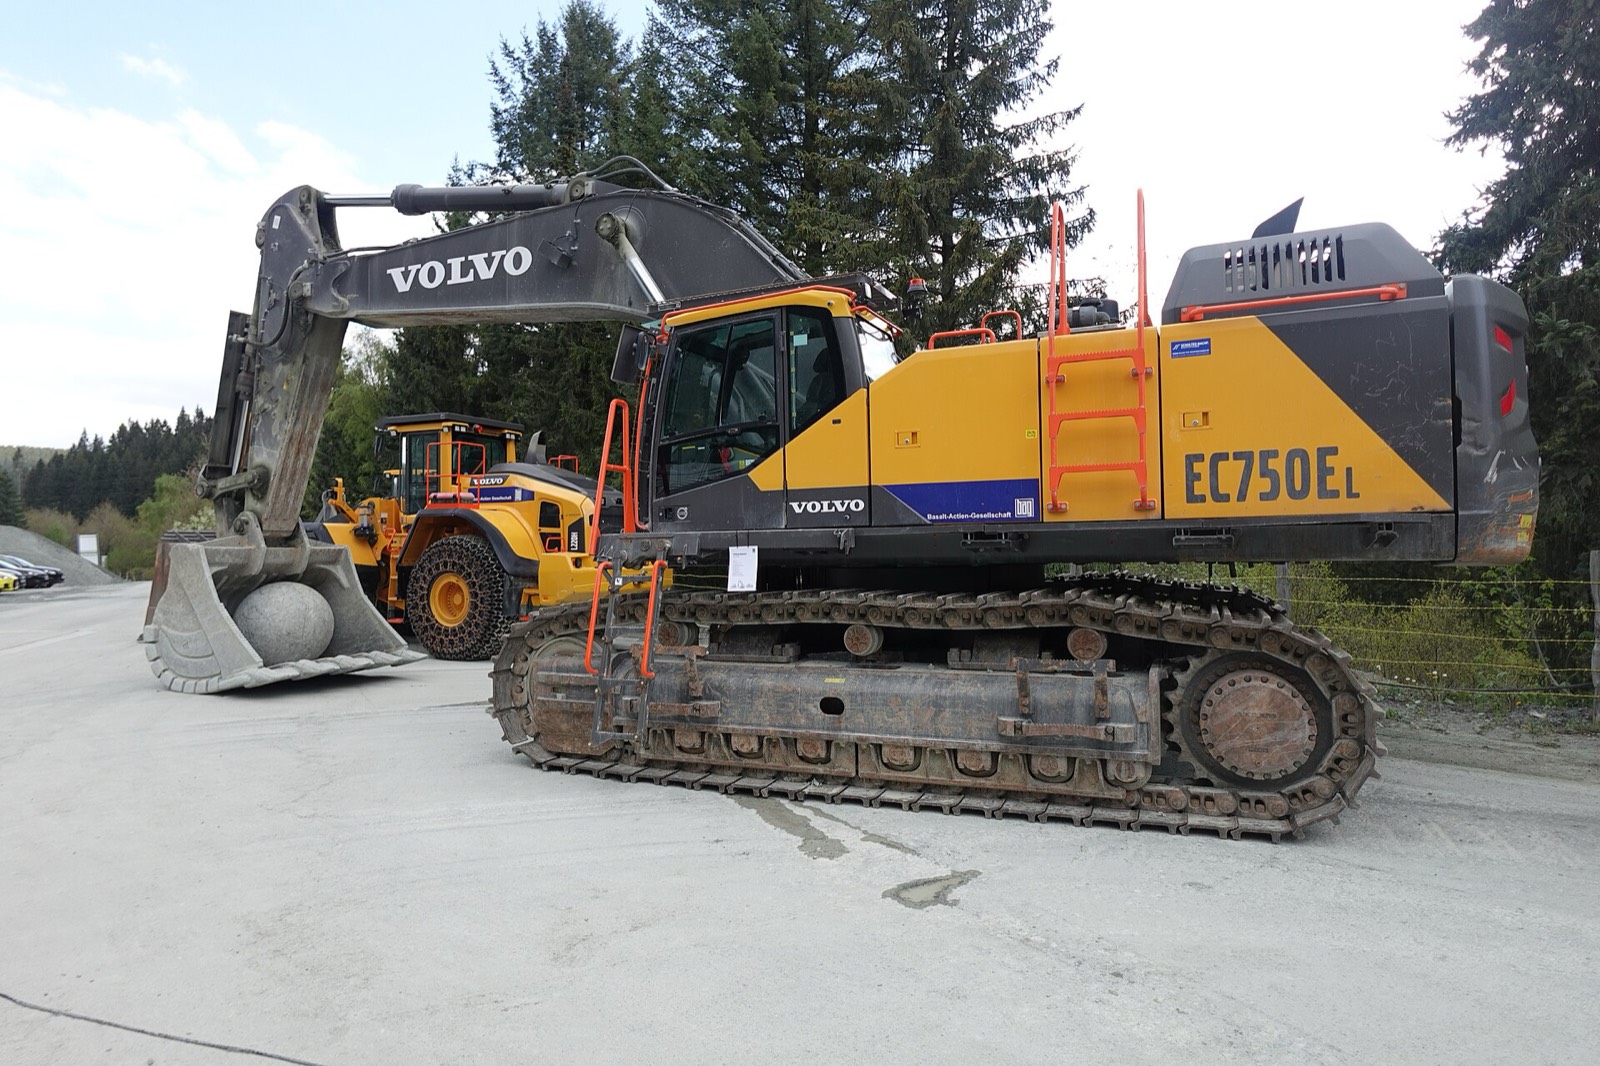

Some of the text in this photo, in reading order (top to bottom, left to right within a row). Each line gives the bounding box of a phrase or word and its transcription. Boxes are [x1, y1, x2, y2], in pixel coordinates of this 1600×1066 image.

[387, 246, 533, 293] VOLVO
[789, 499, 865, 514] VOLVO
[570, 531, 579, 551] L220H
